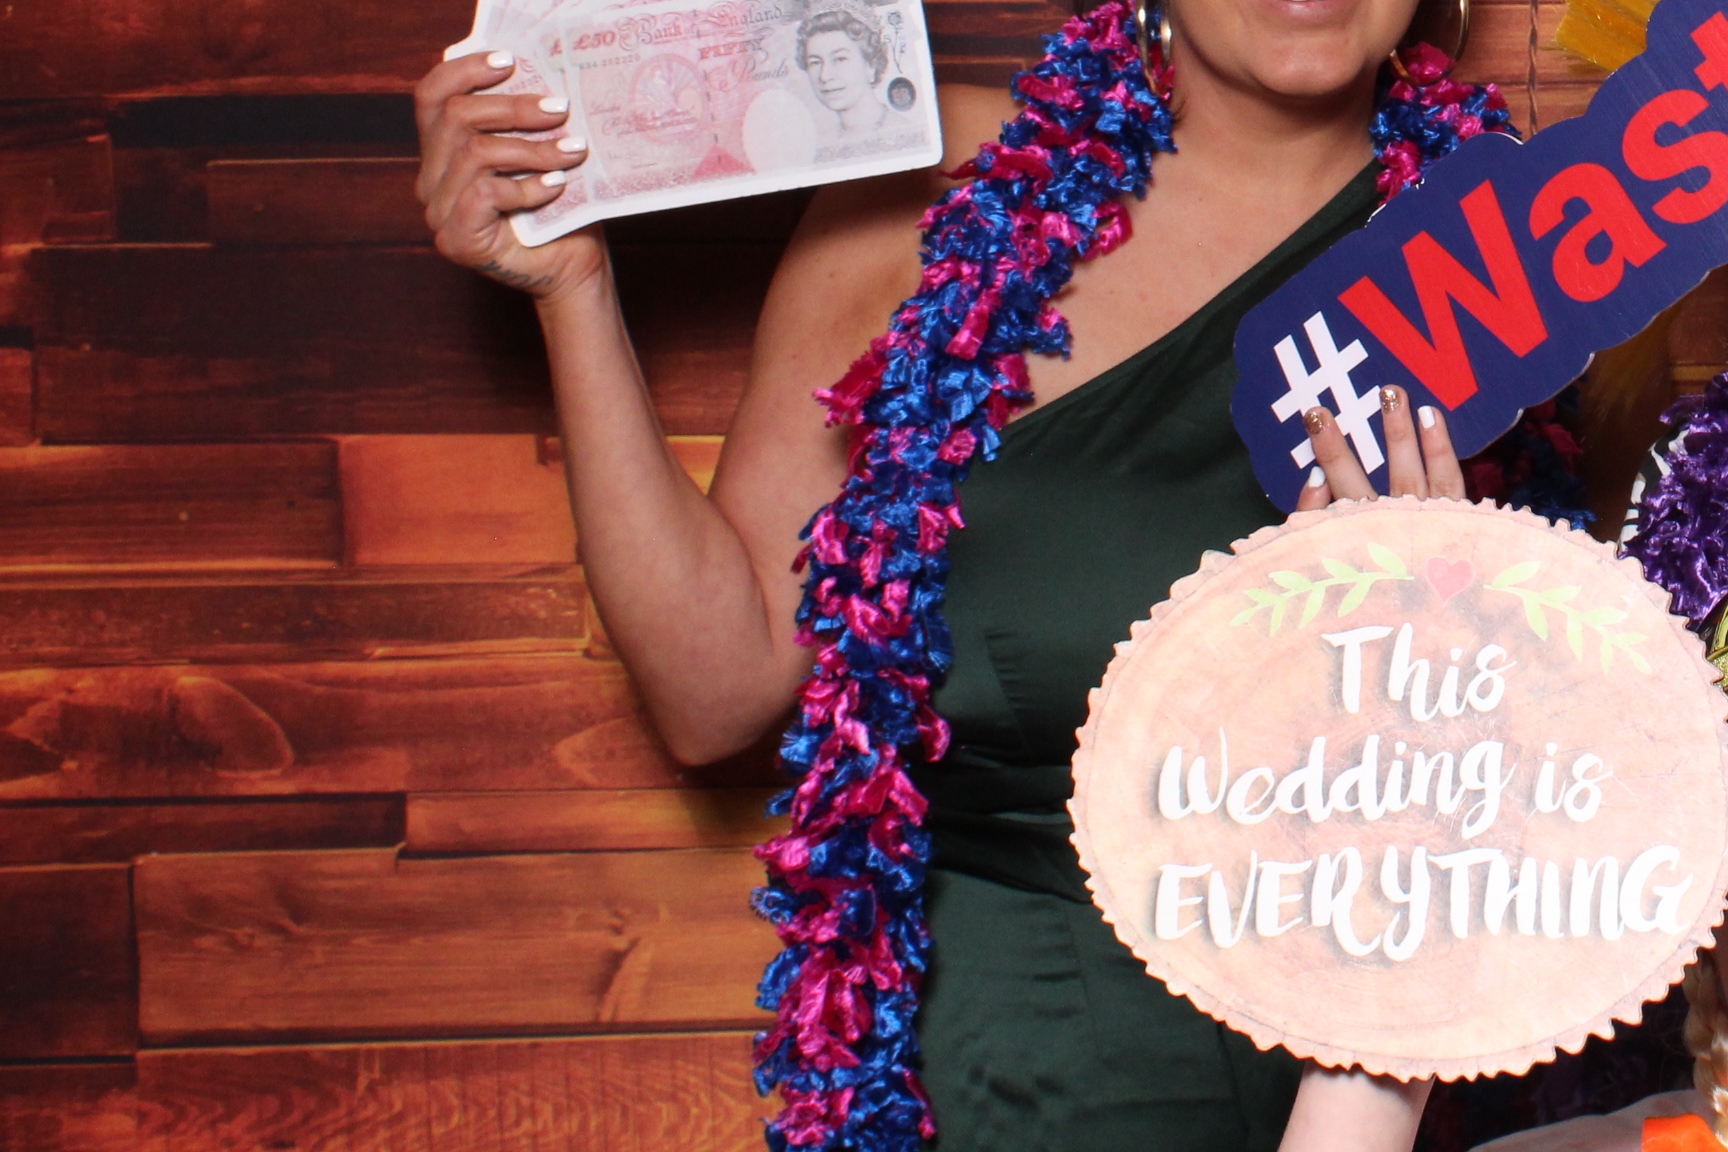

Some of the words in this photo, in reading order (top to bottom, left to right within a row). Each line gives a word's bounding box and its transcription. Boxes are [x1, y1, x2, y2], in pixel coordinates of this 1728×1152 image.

[573, 31, 617, 50] £50
[1321, 622, 1517, 722] This
[1156, 726, 1514, 840] Wedding
[1534, 742, 1614, 822] is
[1155, 844, 1694, 962] EVERYTHING
